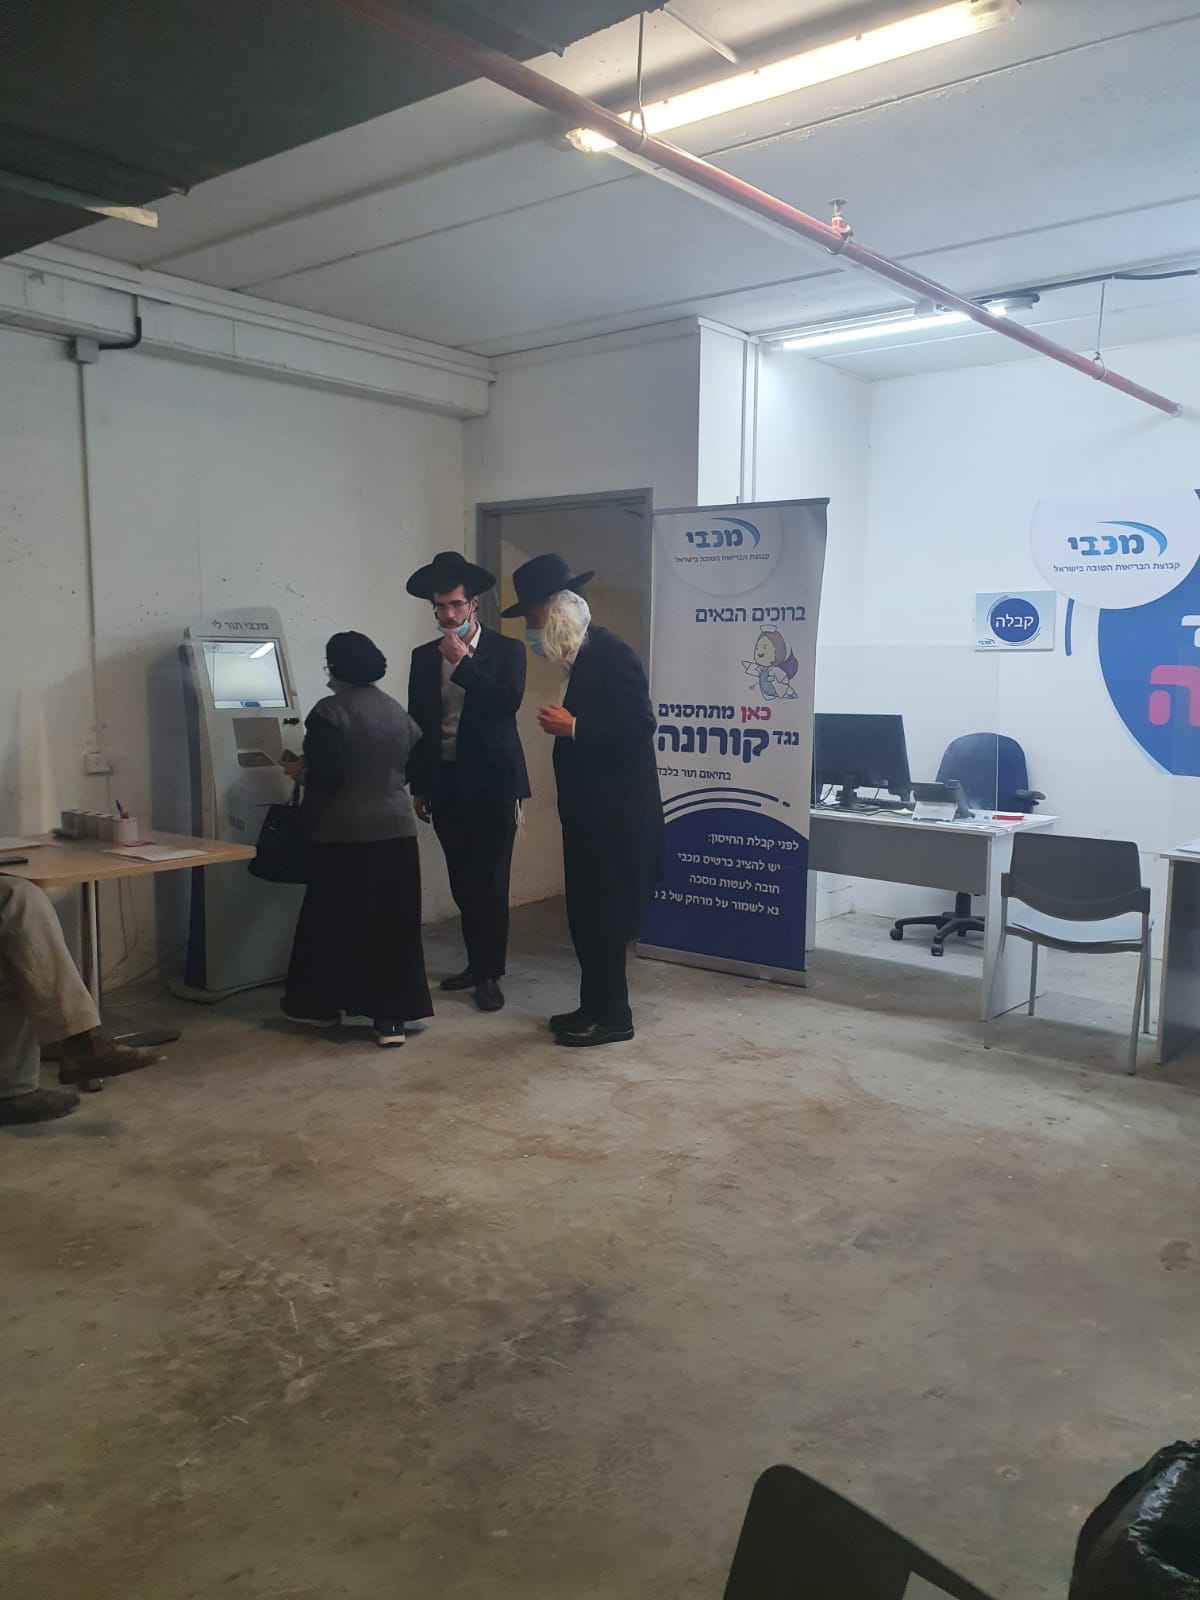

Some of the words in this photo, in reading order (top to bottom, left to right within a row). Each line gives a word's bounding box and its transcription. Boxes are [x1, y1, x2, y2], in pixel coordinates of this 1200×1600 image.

[686, 529, 744, 549] מכבי
[1067, 534, 1145, 556] מכבי
[1053, 564, 1084, 573] בישראל
[1115, 562, 1151, 571] הבריאות
[1153, 562, 1181, 571] קבוצת
[695, 608, 747, 622] הבאים
[751, 606, 806, 622] ברוכים
[995, 613, 1034, 630] קבלה
[658, 703, 735, 719] מתחסנים
[740, 706, 772, 723] כאן
[658, 725, 770, 763] קורונה
[773, 730, 800, 746] נגד
[681, 768, 697, 779] תור
[699, 769, 732, 780] בתיאום
[708, 833, 744, 845] החיסון:
[746, 835, 775, 850] קבלת
[777, 840, 799, 851] לפני
[678, 852, 701, 863] מכבי
[702, 855, 734, 867] כרטיס
[736, 859, 765, 871] להציג
[767, 863, 781, 872] יש
[689, 874, 717, 885] מסכה
[719, 878, 752, 890] לעטות
[754, 881, 780, 894] חובה
[660, 890, 667, 899] 2
[669, 890, 684, 902] של
[685, 894, 713, 905] מרחק
[715, 896, 729, 909] על
[731, 900, 765, 913] לשמור
[767, 905, 779, 916] נא
